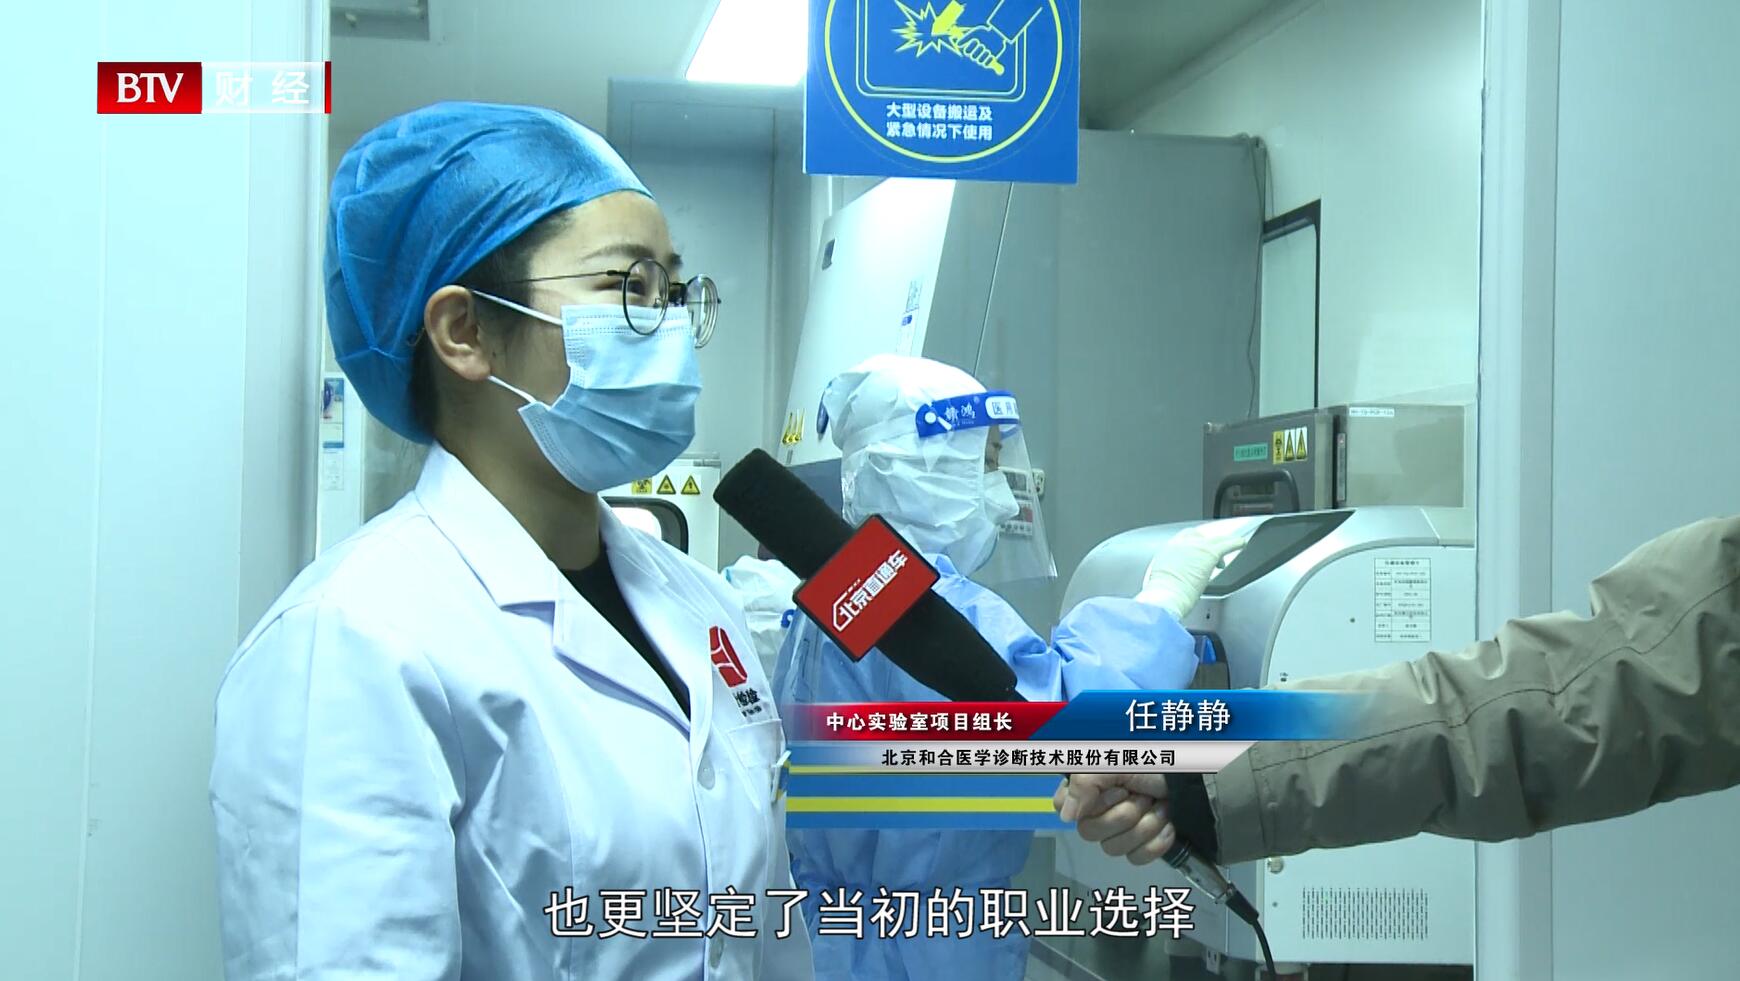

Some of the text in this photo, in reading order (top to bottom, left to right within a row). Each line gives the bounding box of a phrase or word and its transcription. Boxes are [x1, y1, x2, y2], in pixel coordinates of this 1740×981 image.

[886, 101, 993, 122] 大型设备搬运及
[886, 121, 993, 141] 紧急情况下使用
[834, 550, 908, 629] 北京直通车
